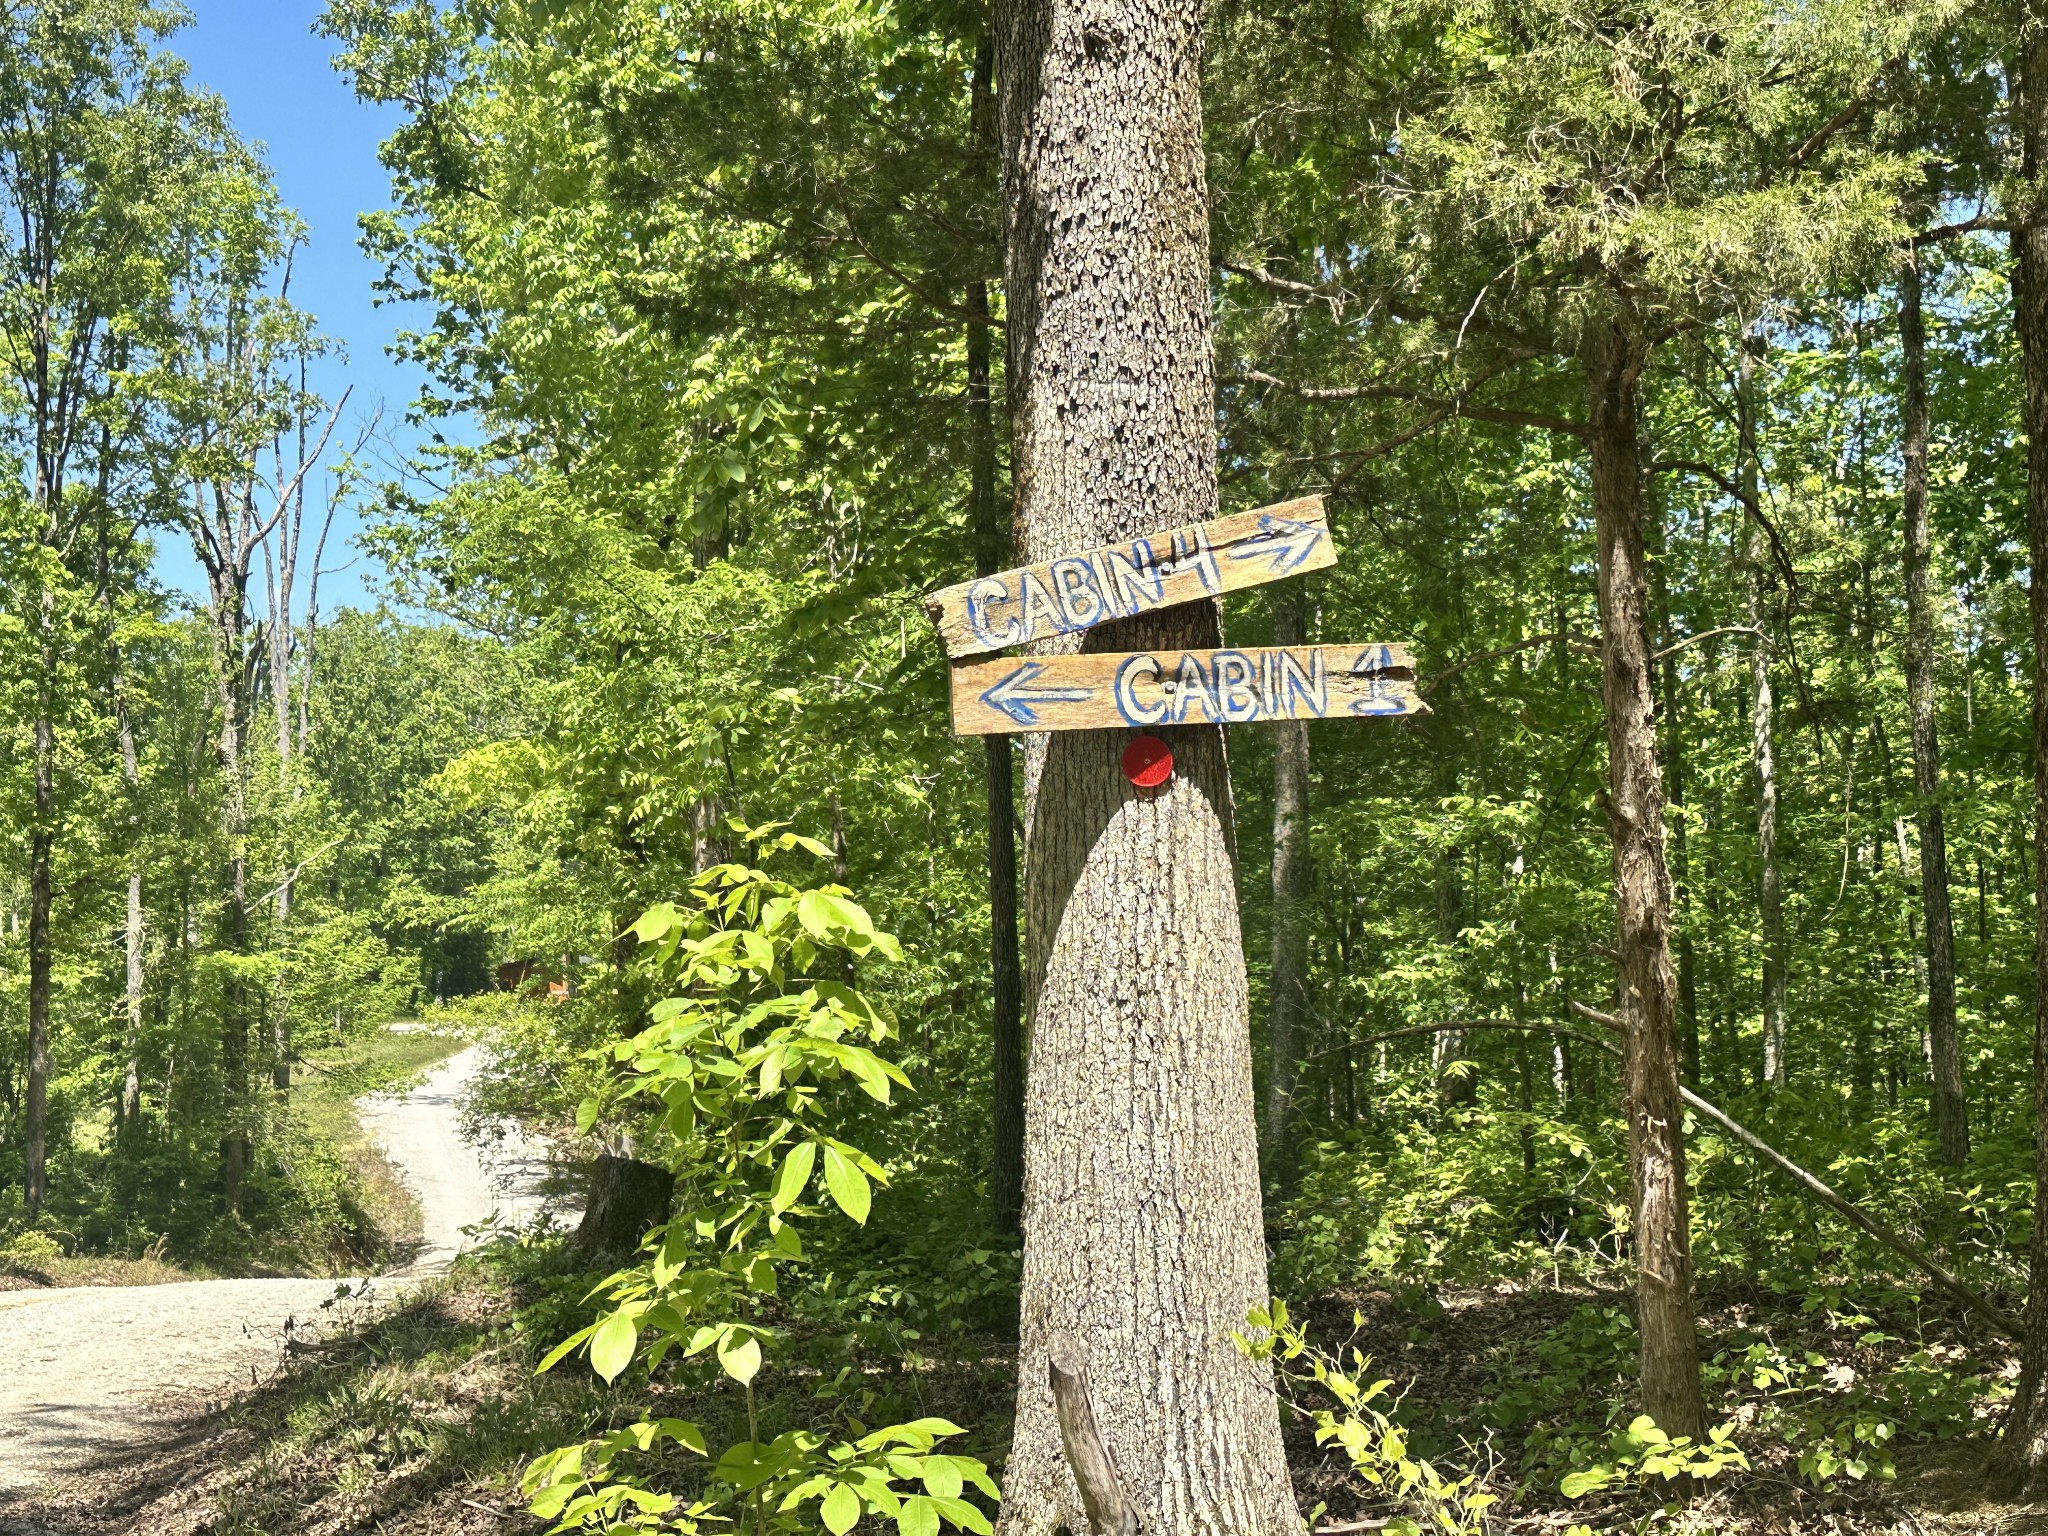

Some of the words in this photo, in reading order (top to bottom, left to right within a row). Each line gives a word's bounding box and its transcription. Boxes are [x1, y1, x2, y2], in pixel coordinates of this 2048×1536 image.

[968, 538, 1164, 648] CABIN
[1169, 523, 1222, 595] 4
[1114, 648, 1327, 726] CABIN
[1348, 645, 1407, 716] 1
